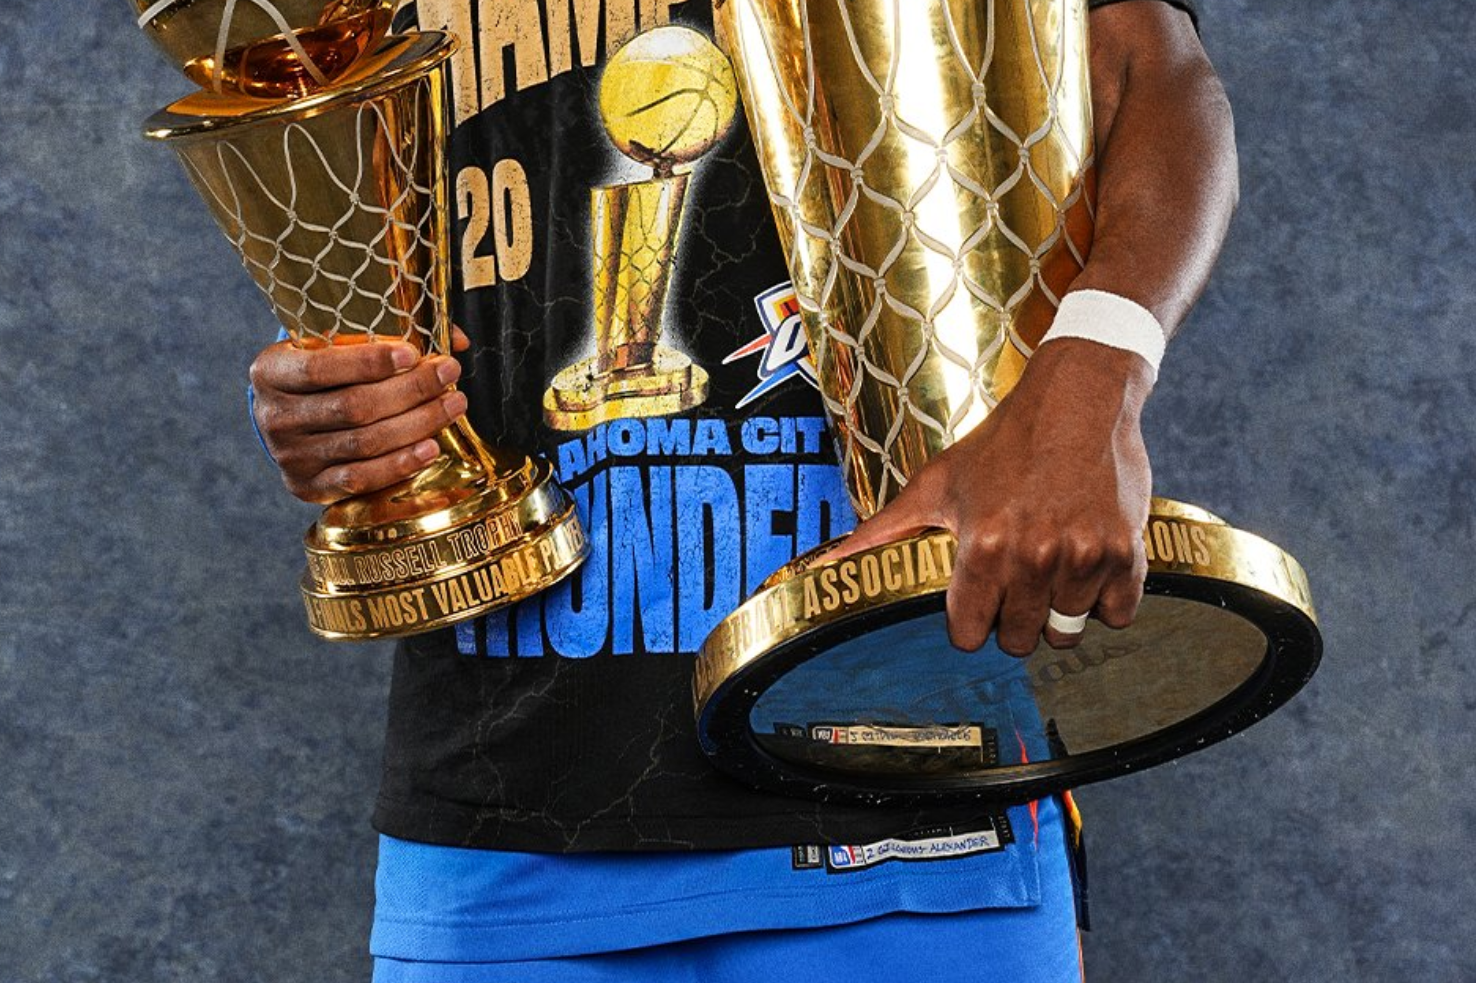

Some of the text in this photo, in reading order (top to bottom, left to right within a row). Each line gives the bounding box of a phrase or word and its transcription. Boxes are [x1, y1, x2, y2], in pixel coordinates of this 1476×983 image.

[455, 158, 533, 292] 20
[540, 416, 826, 485] AHOMA CIT
[355, 540, 448, 584] RUSSELL
[449, 506, 524, 562] TROPHY
[803, 533, 956, 620] ASSOCIAT
[312, 594, 368, 632] FINALS
[370, 587, 431, 630] MOST
[431, 549, 541, 617] VALUABLE
